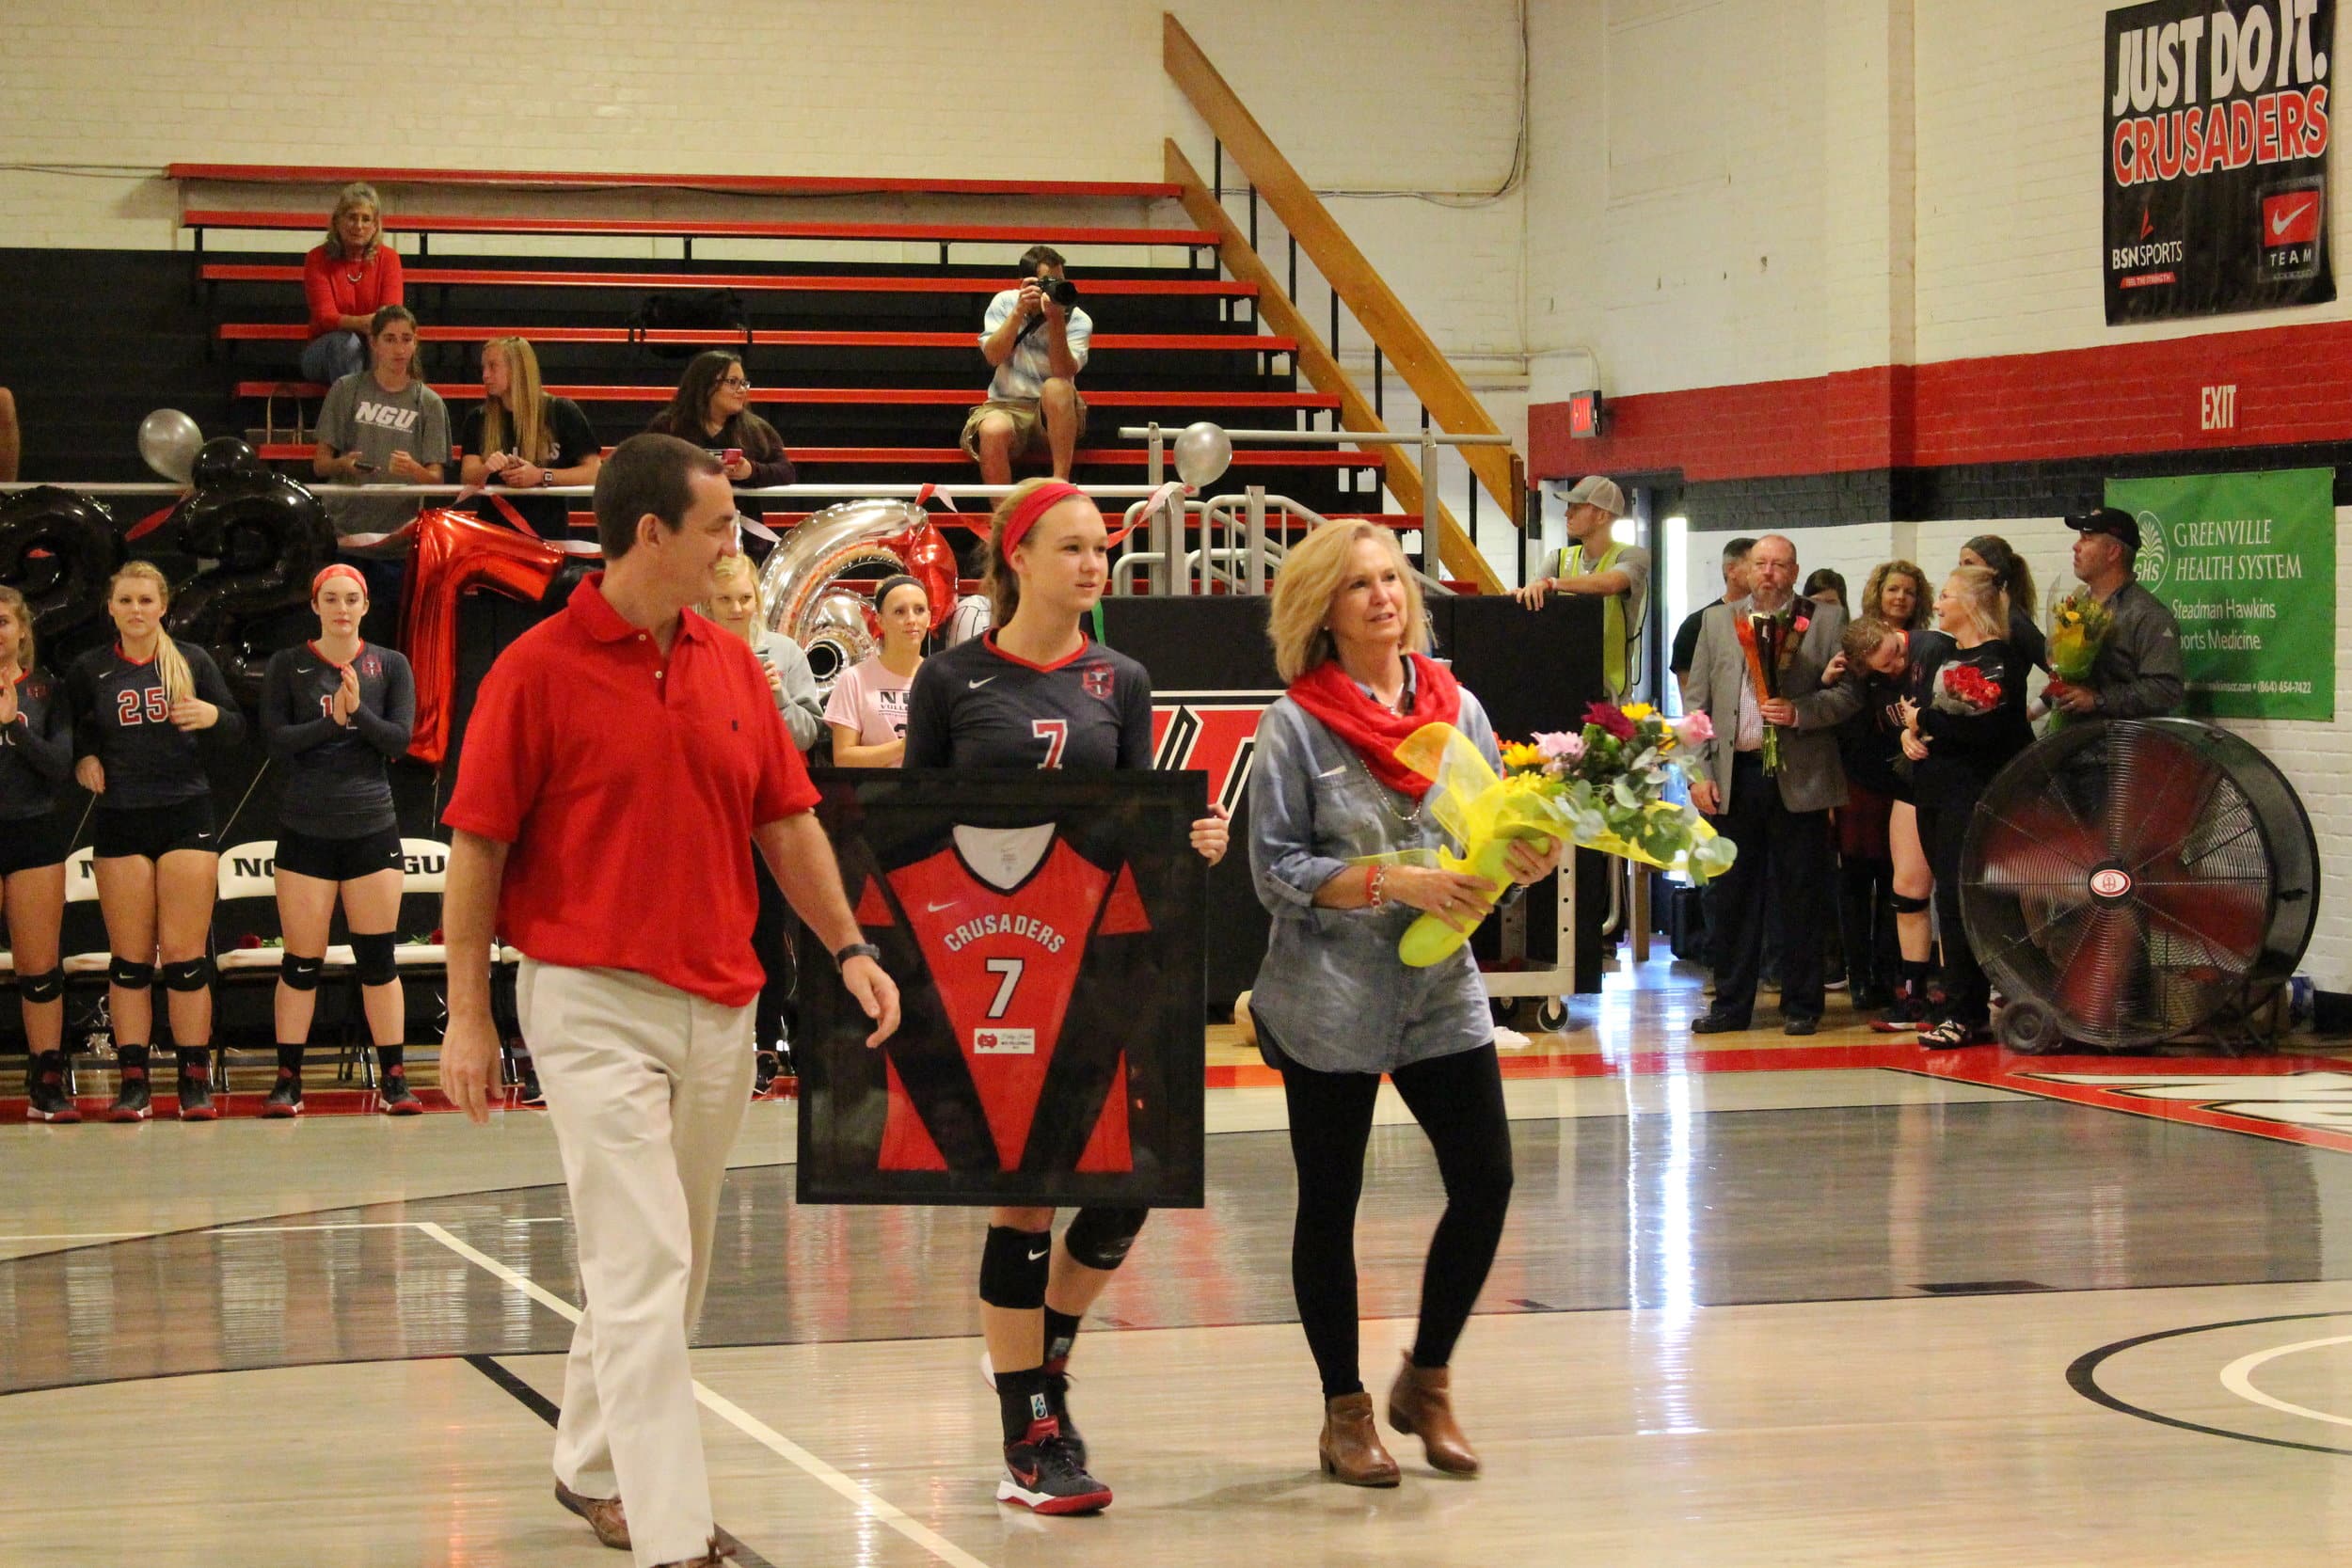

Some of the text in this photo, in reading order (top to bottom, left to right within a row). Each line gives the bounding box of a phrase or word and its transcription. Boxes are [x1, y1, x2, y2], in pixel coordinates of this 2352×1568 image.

[2113, 16, 2203, 117] JUST
[2211, 5, 2273, 99] DO
[2113, 85, 2328, 187] CRUSADERS
[2270, 248, 2312, 267] TEAM
[356, 401, 420, 429] NGU
[2201, 385, 2237, 430] EXIT
[2174, 519, 2272, 547] GREENVILLE
[2175, 554, 2303, 580] HEALTH SYSTEM
[2172, 597, 2277, 619] Steadman Hawkins
[2180, 628, 2263, 651] orts Medicine
[118, 688, 169, 726] 25
[1031, 720, 1069, 769] 7
[944, 913, 1066, 954] CRUSADERS
[985, 957, 1025, 1020] 7
